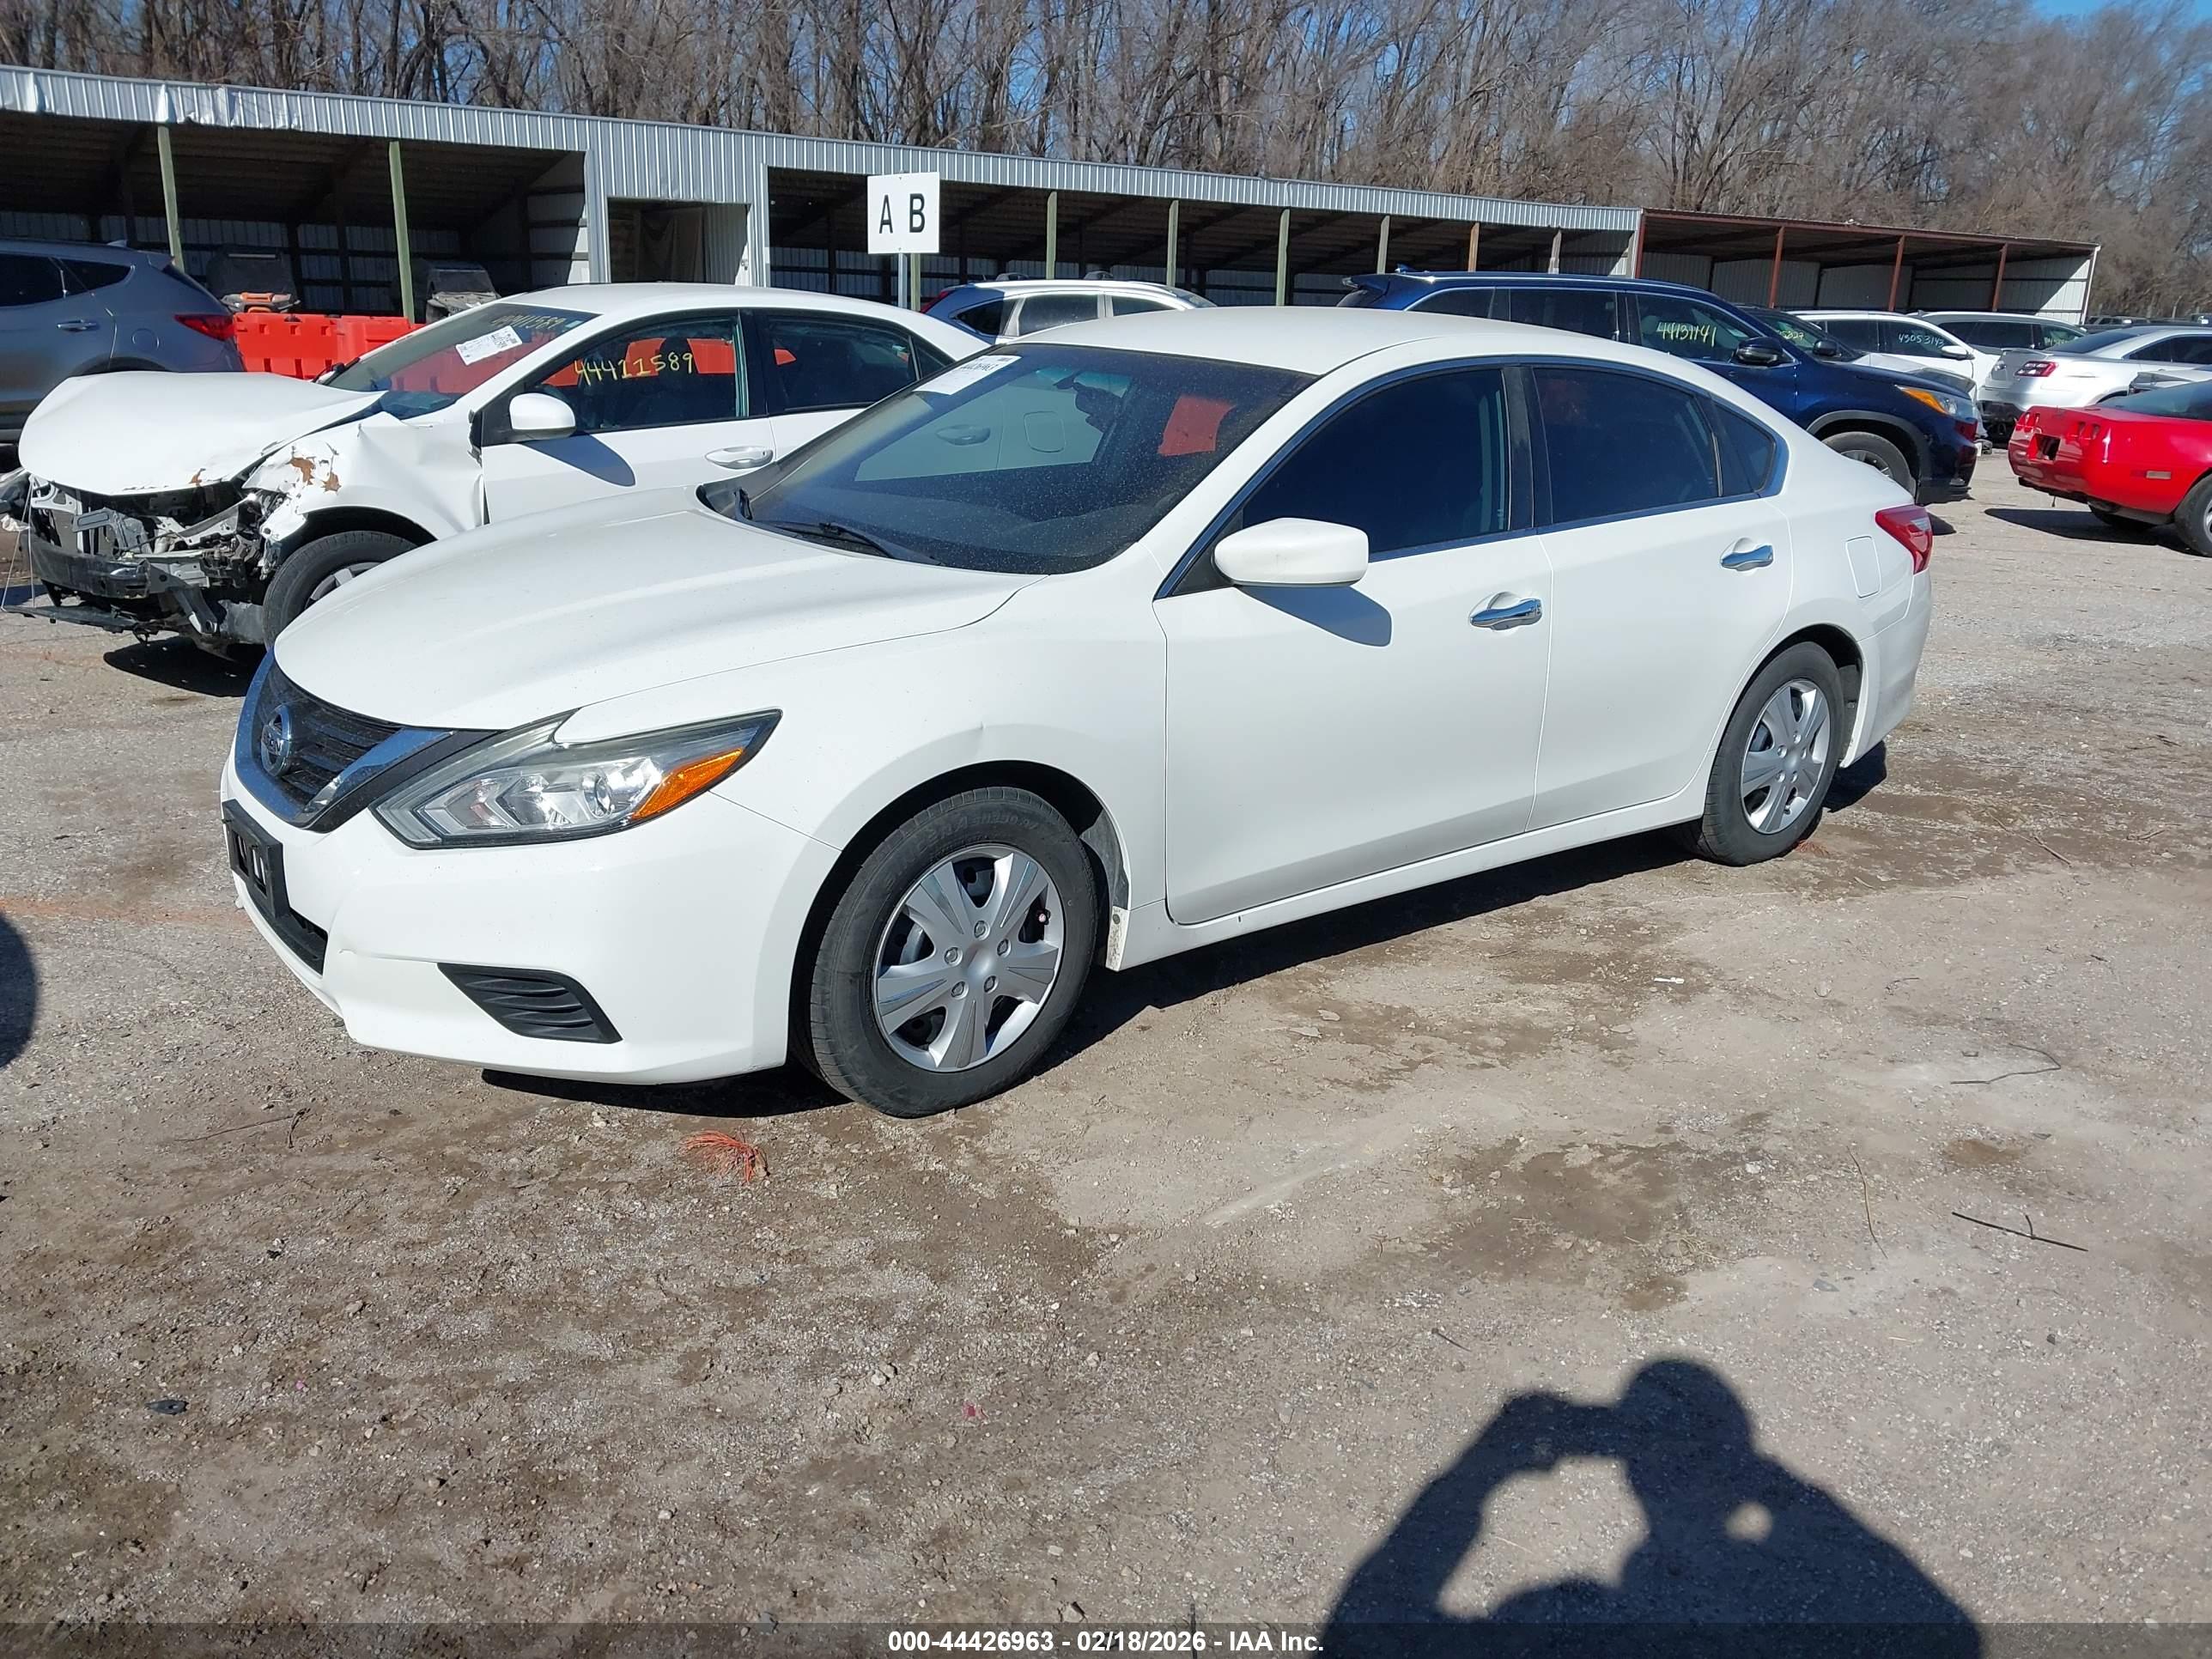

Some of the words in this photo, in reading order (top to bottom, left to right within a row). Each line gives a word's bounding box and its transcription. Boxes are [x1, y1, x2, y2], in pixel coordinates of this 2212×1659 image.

[878, 194, 894, 234] A
[908, 193, 926, 234] B
[574, 351, 694, 386] 44411589
